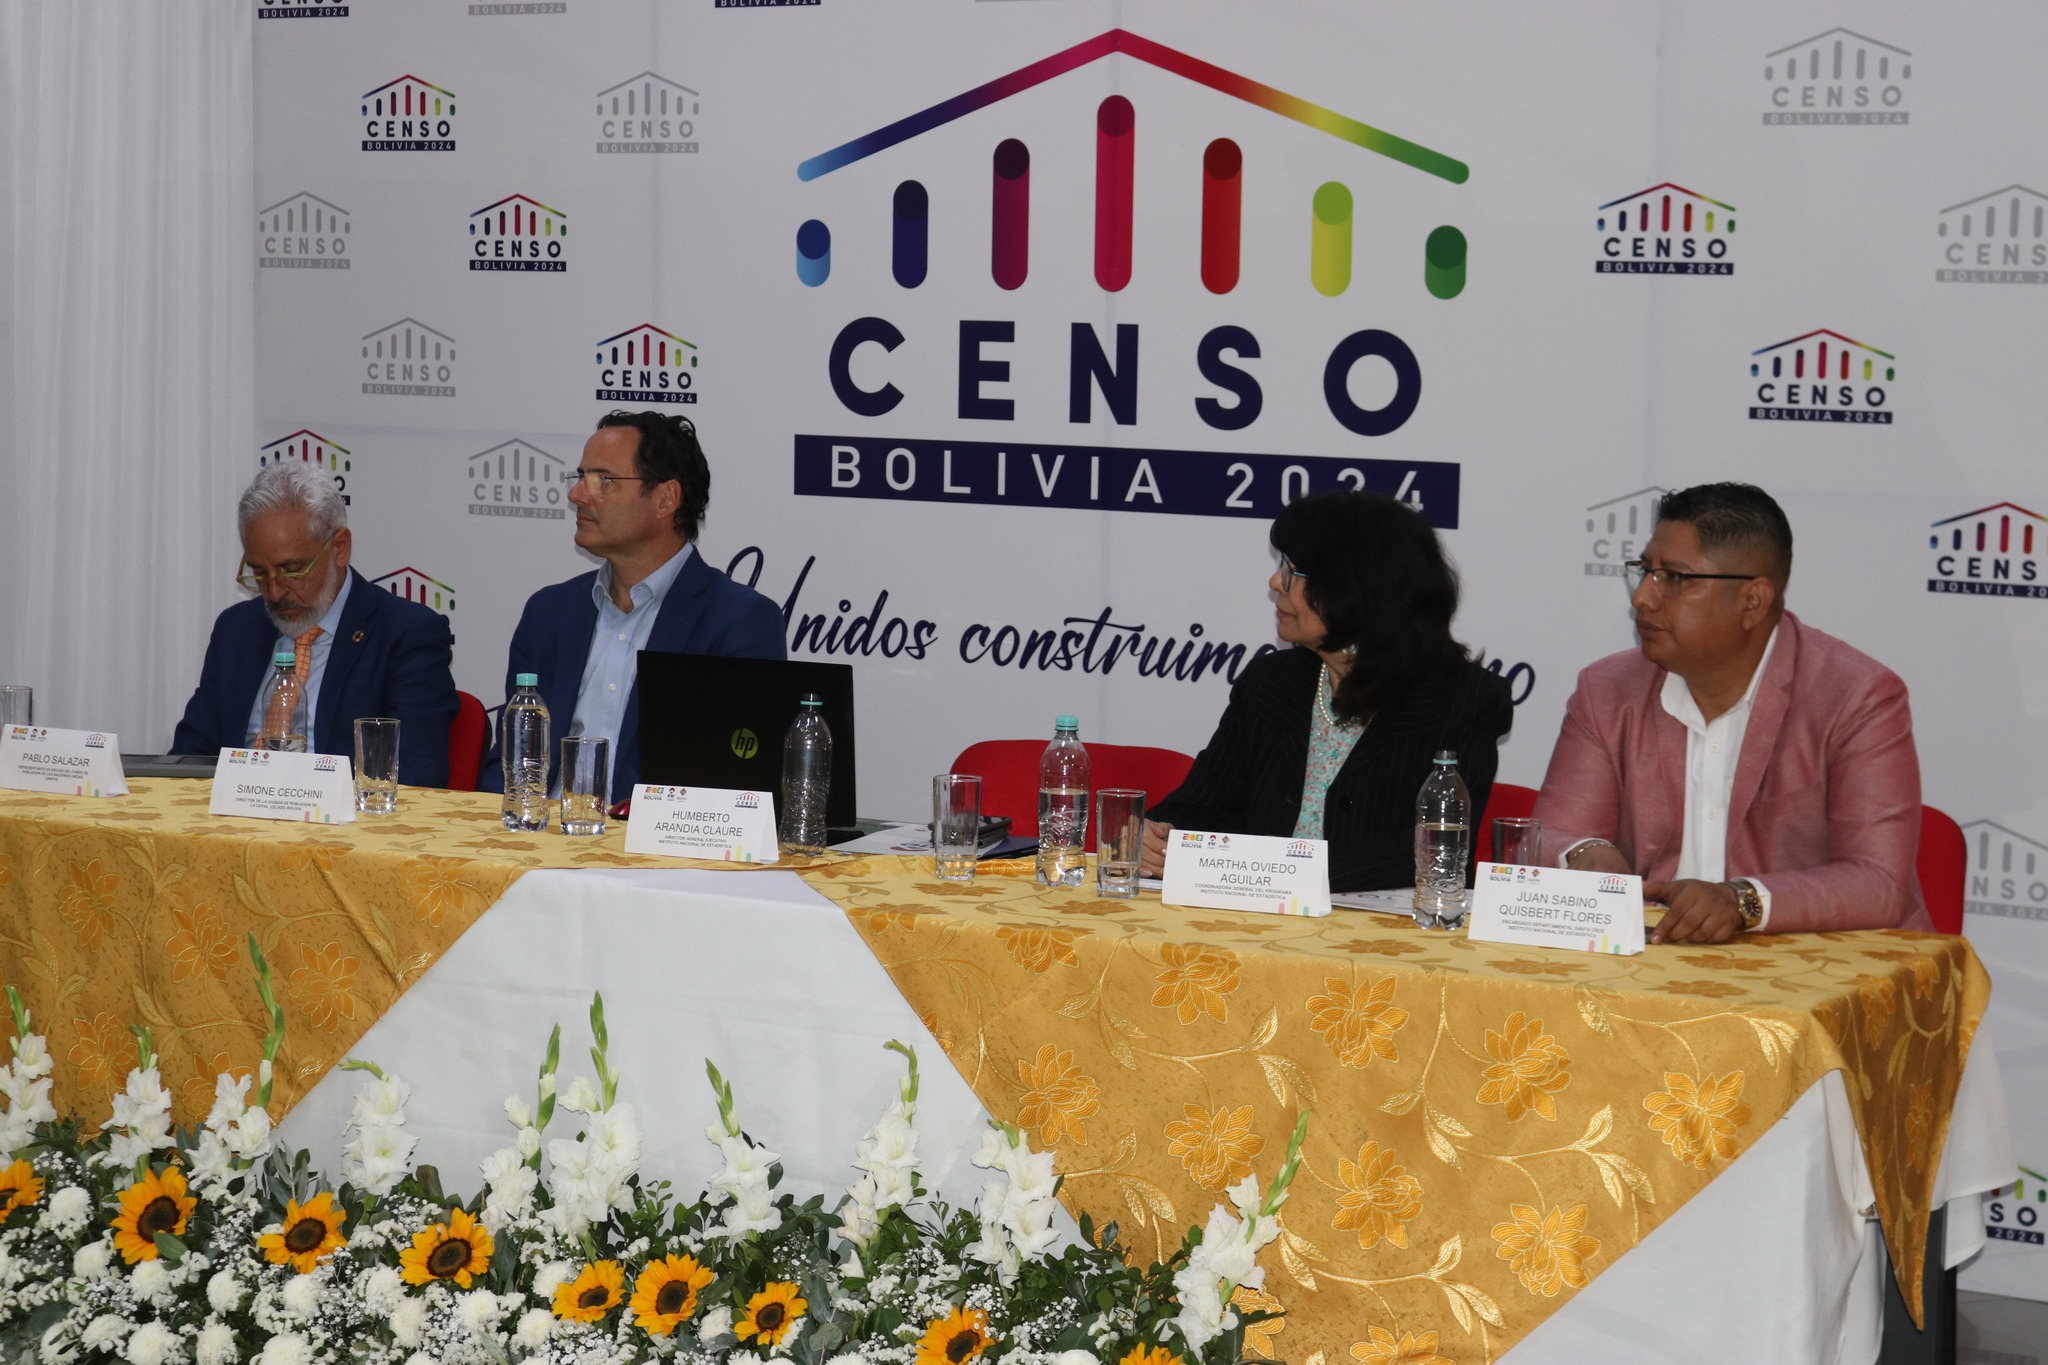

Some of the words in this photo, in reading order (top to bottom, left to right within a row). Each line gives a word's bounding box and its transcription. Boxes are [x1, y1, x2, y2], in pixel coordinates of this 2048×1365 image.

[263, 8, 311, 18] BOLIVIA
[318, 8, 345, 16] 2024
[473, 5, 526, 14] BOLIVIA
[533, 4, 562, 13] 2024
[1771, 85, 1902, 108] CENSO
[1769, 113, 1849, 125] BOLIVIA
[1859, 113, 1904, 125] 2024
[367, 120, 451, 138] CENSO
[602, 120, 694, 139] CENSO
[366, 141, 418, 151] BOLIVIA
[423, 141, 452, 151] 2024
[601, 143, 655, 153] BOLIVIA
[663, 143, 696, 153] 2024
[264, 237, 346, 255] CENSO
[474, 240, 562, 259] CENSO
[1603, 237, 1727, 259] CENSO
[1945, 243, 2048, 266] CENS
[264, 258, 314, 268] BOLIVIA
[318, 259, 347, 269] 2024
[474, 261, 527, 271] BOLIVIA
[533, 261, 563, 272] 2024
[1602, 262, 1677, 274] BOLIVIA
[1686, 263, 1729, 275] 2024
[1944, 271, 2025, 282] BOLIVIA
[367, 363, 452, 383] CENSO
[601, 369, 693, 390] CENSO
[828, 316, 1422, 437] CENSO
[367, 384, 418, 395] BOLIVIA
[423, 386, 453, 397] 2024
[601, 390, 656, 402] BOLIVIA
[662, 392, 694, 404] 2024
[1757, 383, 1886, 408] CENSO
[1755, 408, 1833, 422] BOLIVIA
[1843, 410, 1888, 424] 2024
[830, 445, 1164, 505] BOLIVIA
[473, 484, 561, 504] CENSO
[472, 504, 526, 517] BOLIVIA
[532, 507, 562, 519] 2024
[1937, 556, 2037, 581] CENS
[1935, 581, 2015, 596] BOLIVIA
[2026, 587, 2048, 598] 20
[960, 606, 1281, 686] construim
[734, 728, 756, 759] hp
[22, 753, 50, 764] PABLO
[52, 756, 90, 768] SALAZAR
[236, 784, 276, 796] SIMONE
[278, 787, 323, 799] CECCHINI
[672, 810, 730, 823] HUMBERTO
[654, 822, 700, 834] ARANDIA
[702, 826, 743, 837] CLAURE
[1198, 858, 1248, 871] MARTHA
[1250, 861, 1297, 875] OVIEDO
[1220, 873, 1272, 886] AGUILAR
[1972, 876, 2048, 902] NSO
[1516, 892, 1549, 905] JUAN
[1552, 894, 1598, 909] SABINO
[1500, 904, 1560, 920] QUISBERT
[1563, 910, 1612, 925] FLORES
[1532, 922, 1573, 930] DEPARTAMENTAL
[1995, 1227, 2038, 1242] 2024
